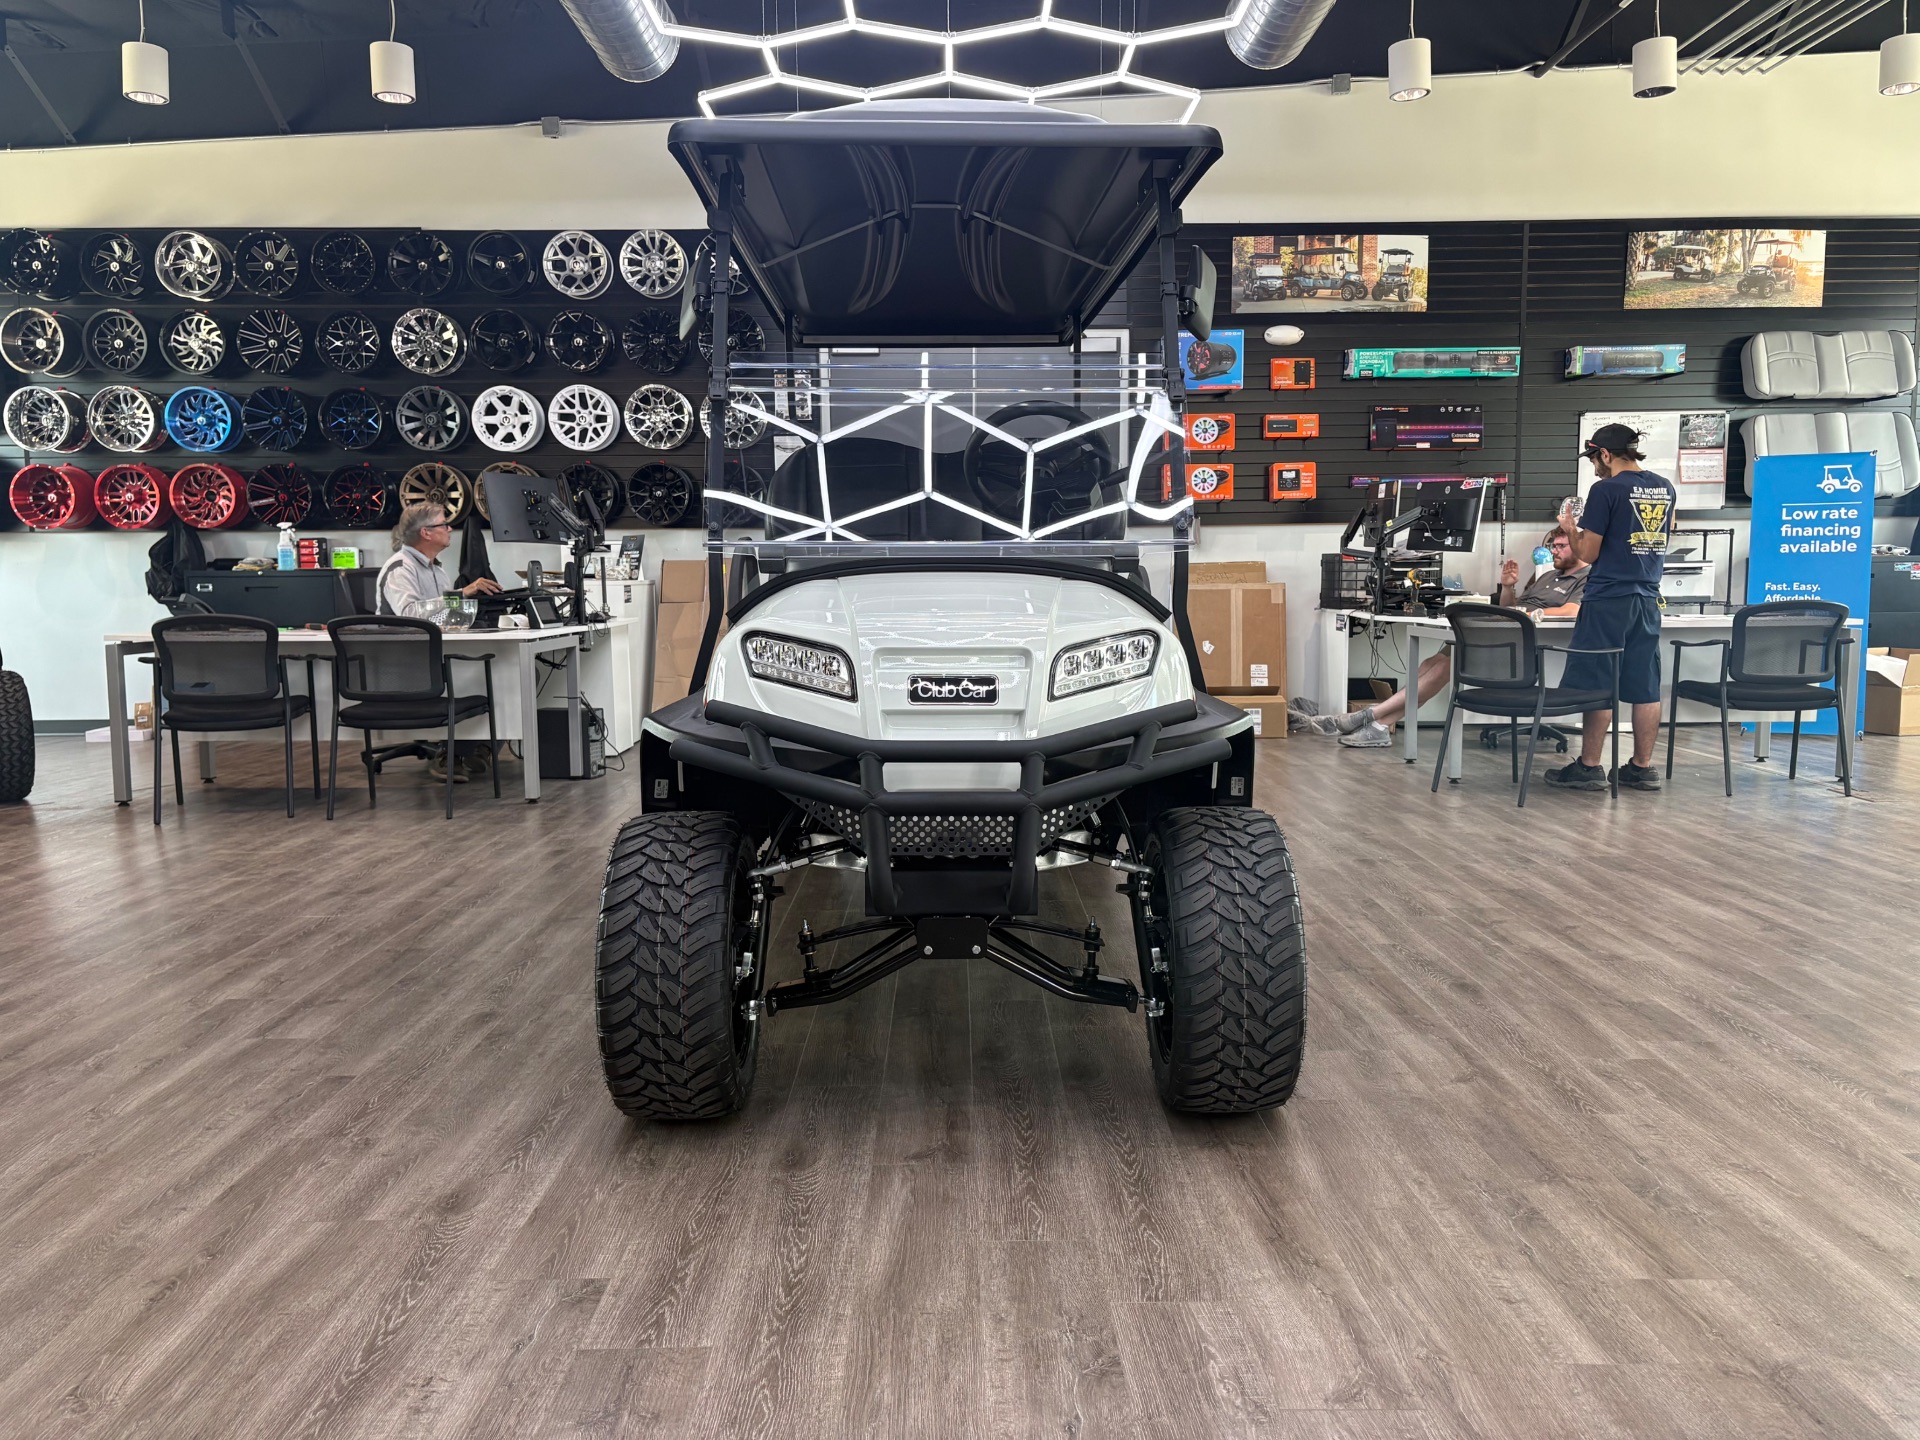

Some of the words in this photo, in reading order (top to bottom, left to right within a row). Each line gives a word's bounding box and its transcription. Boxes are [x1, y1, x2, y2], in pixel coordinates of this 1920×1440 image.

[1639, 504, 1666, 519] 34
[1781, 507, 1819, 520] Low
[1822, 507, 1858, 519] rate
[1780, 523, 1861, 538] financing
[1779, 540, 1858, 553] available
[1764, 582, 1791, 591] Fast.
[1793, 582, 1821, 593] Easy.
[1764, 593, 1822, 602] Affordable
[917, 681, 957, 698] Club
[959, 681, 987, 698] Car
